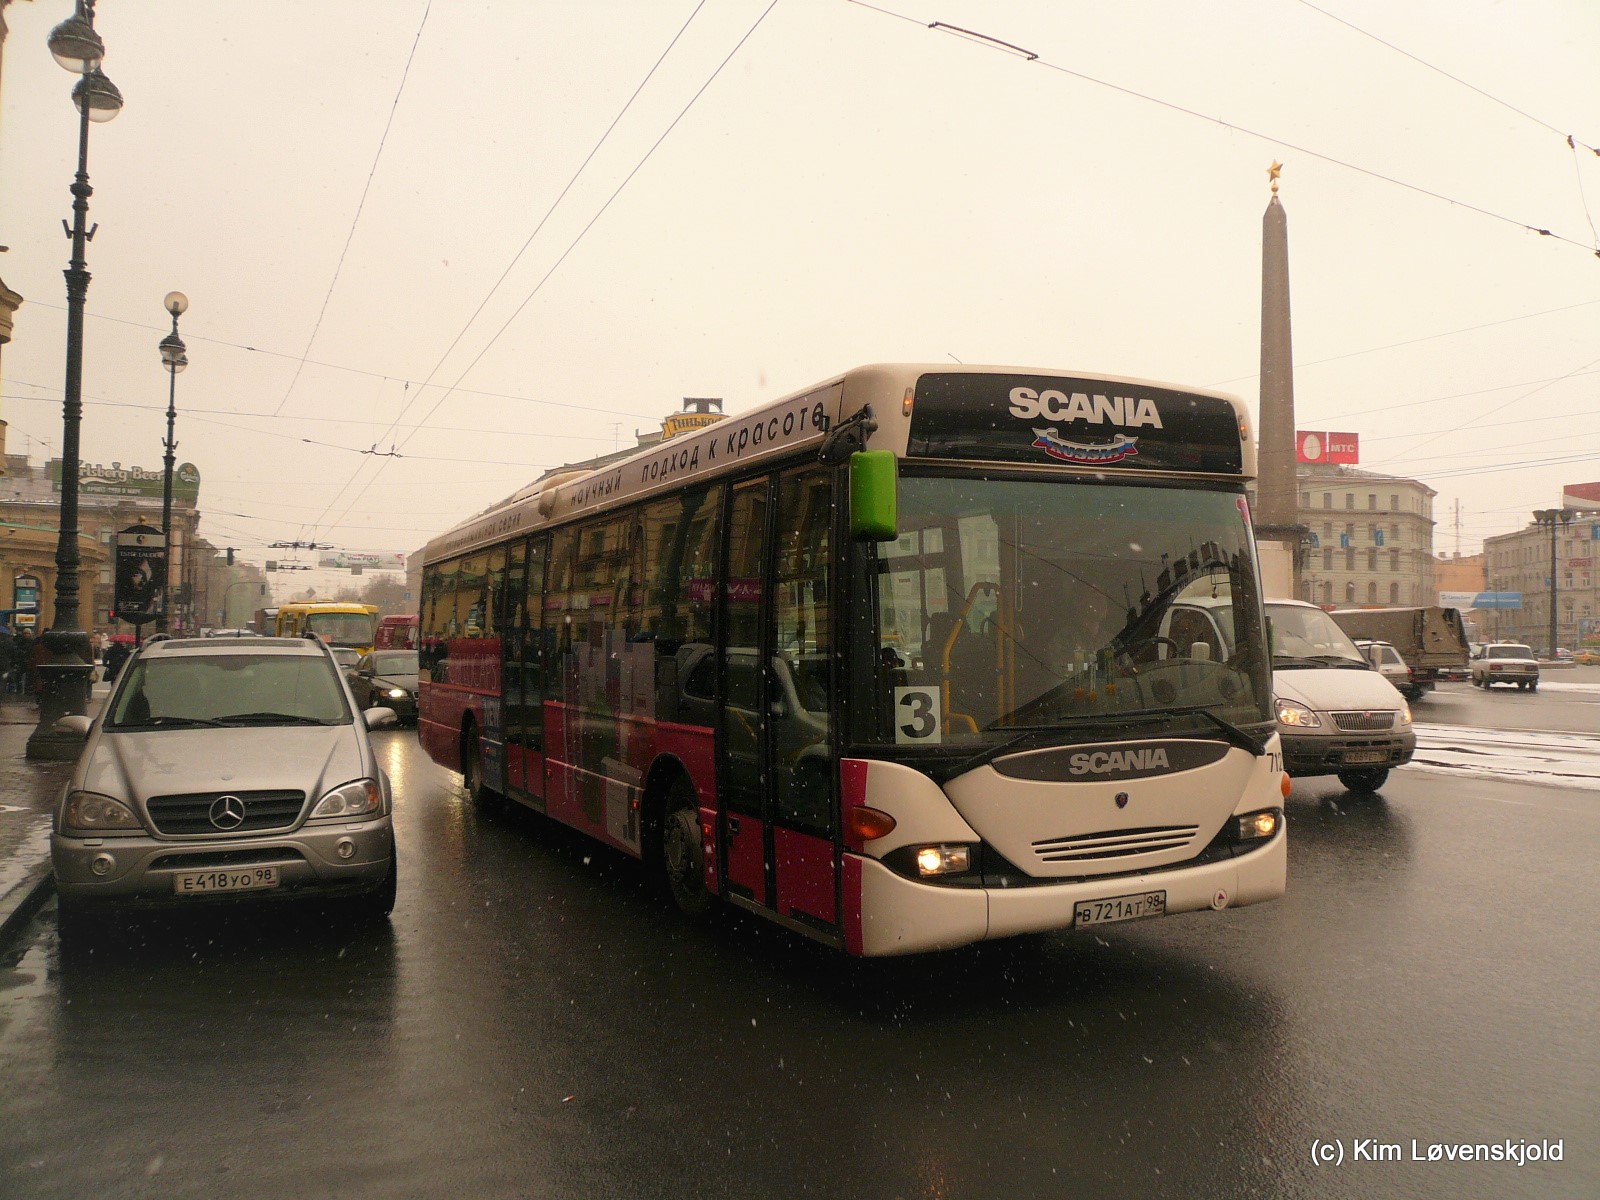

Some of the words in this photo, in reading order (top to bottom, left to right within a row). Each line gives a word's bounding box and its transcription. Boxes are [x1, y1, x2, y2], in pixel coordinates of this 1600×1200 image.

[1008, 387, 1163, 429] SCANIA
[571, 469, 622, 506] научный
[641, 445, 699, 482] подход
[708, 438, 718, 460] к
[727, 402, 824, 457] красоте
[1050, 441, 1119, 460] RUSSIA
[1330, 444, 1355, 453] МТС
[132, 466, 166, 480] Beer
[899, 691, 936, 738] 3
[1069, 748, 1170, 775] SCANIA
[256, 869, 272, 880] 98
[1147, 894, 1160, 909] 98
